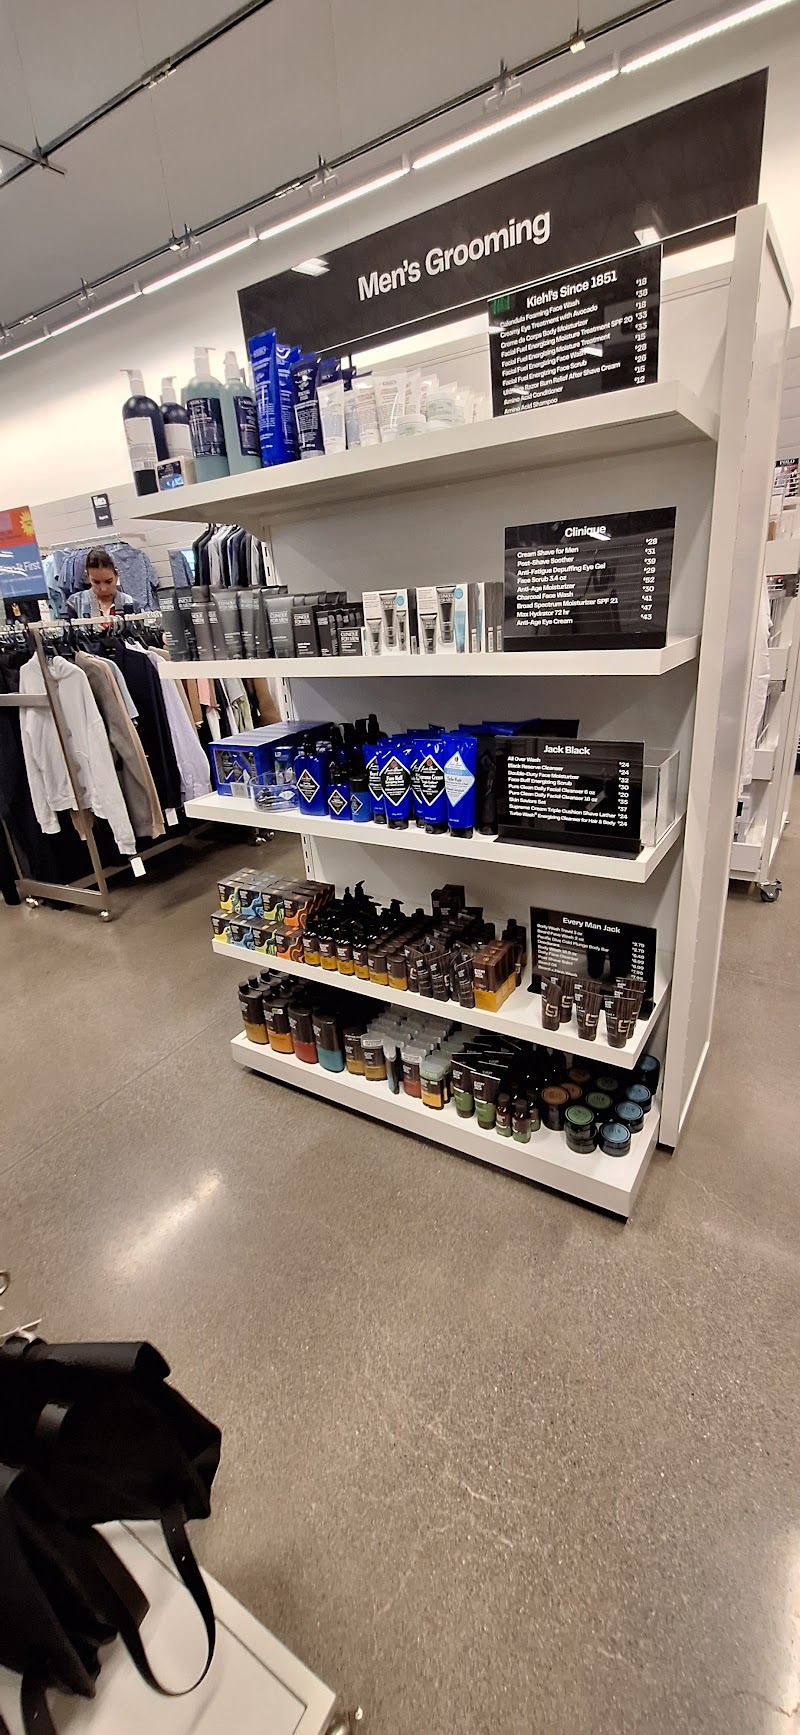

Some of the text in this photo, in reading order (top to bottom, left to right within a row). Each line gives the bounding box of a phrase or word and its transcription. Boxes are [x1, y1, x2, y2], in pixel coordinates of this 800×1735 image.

[358, 212, 551, 301] Men's Grooming
[527, 270, 617, 308] Kiehl's Since 1851
[526, 309, 549, 320] Foaming
[549, 305, 563, 313] Face
[563, 299, 580, 309] Wash
[500, 328, 520, 338] Creamy
[521, 325, 531, 333] Eye
[531, 316, 559, 329] Treatment
[560, 312, 572, 321] with
[572, 305, 598, 317] Avocado
[526, 332, 542, 341] Corps
[542, 328, 557, 337] Body
[557, 319, 589, 332] Moisturizer
[501, 348, 516, 358] Facial
[516, 345, 528, 354] Fuel
[528, 339, 556, 350] Energizing
[556, 332, 580, 342] Moisture
[581, 322, 610, 335] Treatment
[611, 318, 623, 327] SPF
[624, 316, 633, 324] 20
[501, 358, 516, 367] Facial
[516, 355, 528, 363] Fuel
[528, 349, 556, 360] Energizing
[556, 342, 580, 352] Moisture
[581, 333, 611, 346] Treatment
[502, 367, 516, 376] Facial
[517, 364, 528, 373] Fuel
[528, 358, 556, 369] Energizing
[556, 354, 569, 362] Face
[502, 377, 517, 386] Facial
[517, 374, 528, 382] Fuel
[528, 368, 556, 379] Energizing
[570, 360, 587, 369] Scrub
[524, 383, 539, 391] Razor
[553, 374, 568, 383] Relief
[583, 367, 601, 376] Shave
[601, 362, 620, 371] Cream
[504, 397, 520, 405] Amino
[532, 387, 564, 398] Conditioner
[504, 403, 520, 414] Amino
[533, 398, 558, 407] Shampoo
[565, 525, 606, 538] Clinique
[23, 561, 41, 571] First
[517, 568, 552, 576] Anti-Fatigue
[553, 565, 582, 573] Depuffing
[544, 745, 591, 755] Jack Black
[562, 917, 620, 934] Every Man Jack
